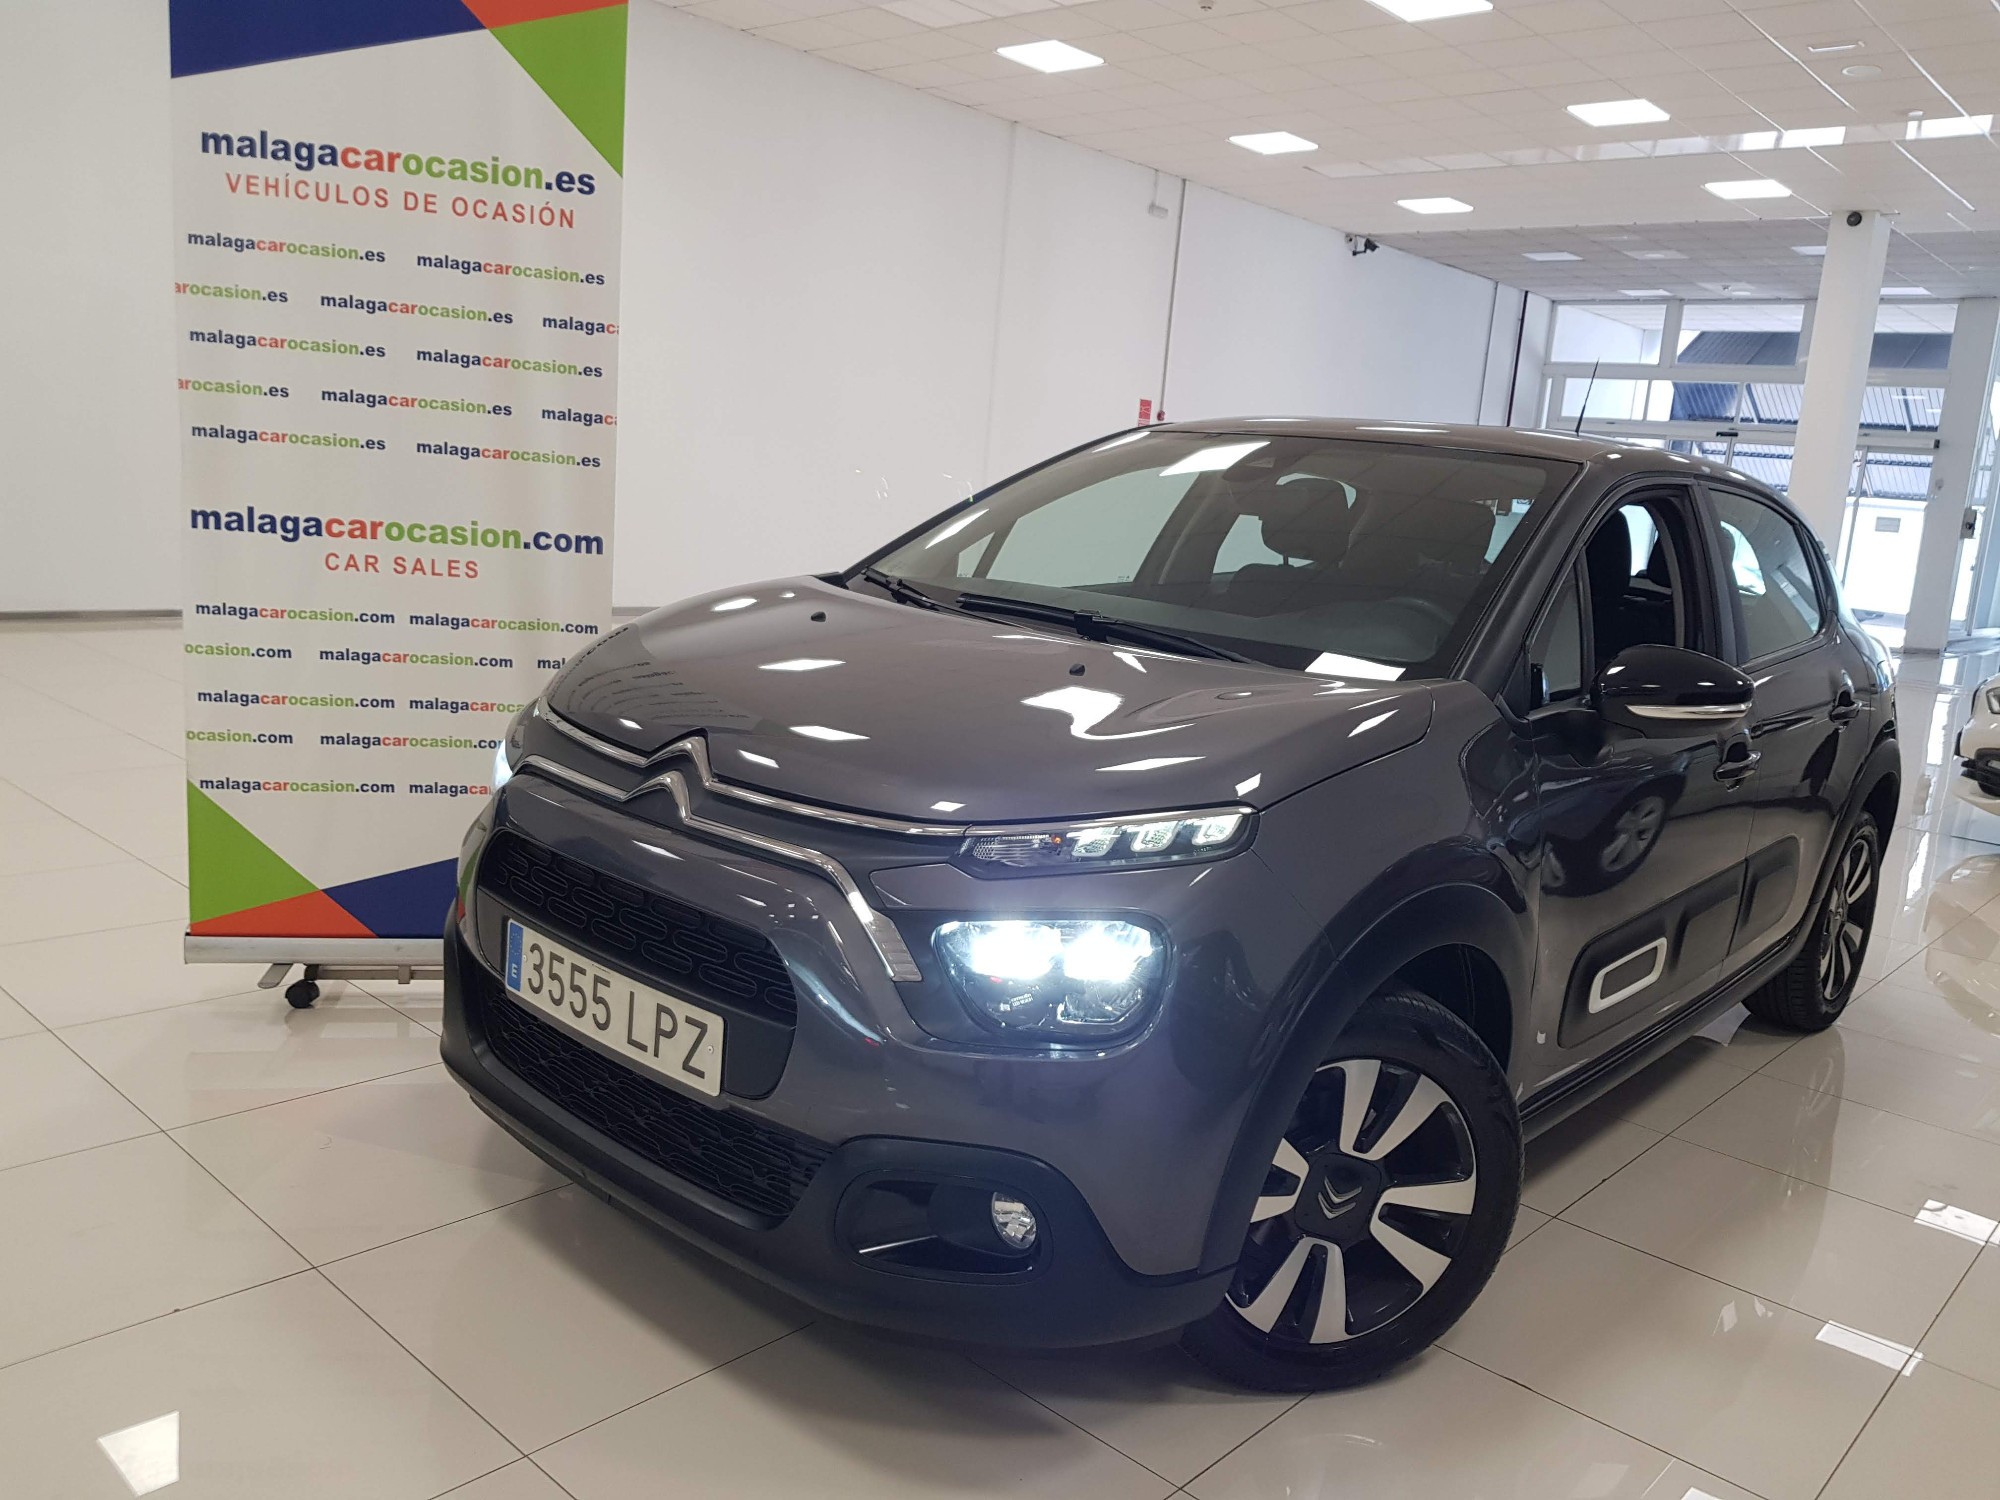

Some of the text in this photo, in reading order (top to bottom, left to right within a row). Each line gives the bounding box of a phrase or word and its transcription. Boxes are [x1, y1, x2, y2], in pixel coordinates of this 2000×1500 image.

[201, 130, 596, 195] malagacarocasion.es
[226, 172, 574, 228] VEHÍCULOS DE OCASIÓN
[188, 233, 604, 285] malagacarocasion.es malagacarocasion.es
[321, 295, 513, 324] malagacarocasion.es
[543, 316, 619, 335] malagac
[190, 330, 602, 377] malagacarocasion.es malagacarocasion.es
[322, 389, 512, 416] malagacarocasion.es
[542, 408, 617, 426] malagac
[192, 425, 600, 467] malagacarocasion.es malagacarocasion.es
[191, 506, 604, 555] malagacarocasion.com
[325, 553, 478, 578] CAR SALES
[196, 602, 598, 634] malagacarocasion.com malagacarocasion.com
[185, 643, 292, 658] ocasion.com
[320, 648, 513, 668] malagacarocasion.com
[198, 690, 395, 708] malagacarocasion.com
[187, 729, 293, 744] ocasion.com
[200, 777, 491, 796] malagacarocasion.com malagaca
[511, 942, 708, 1080] E 3555 LPZ
